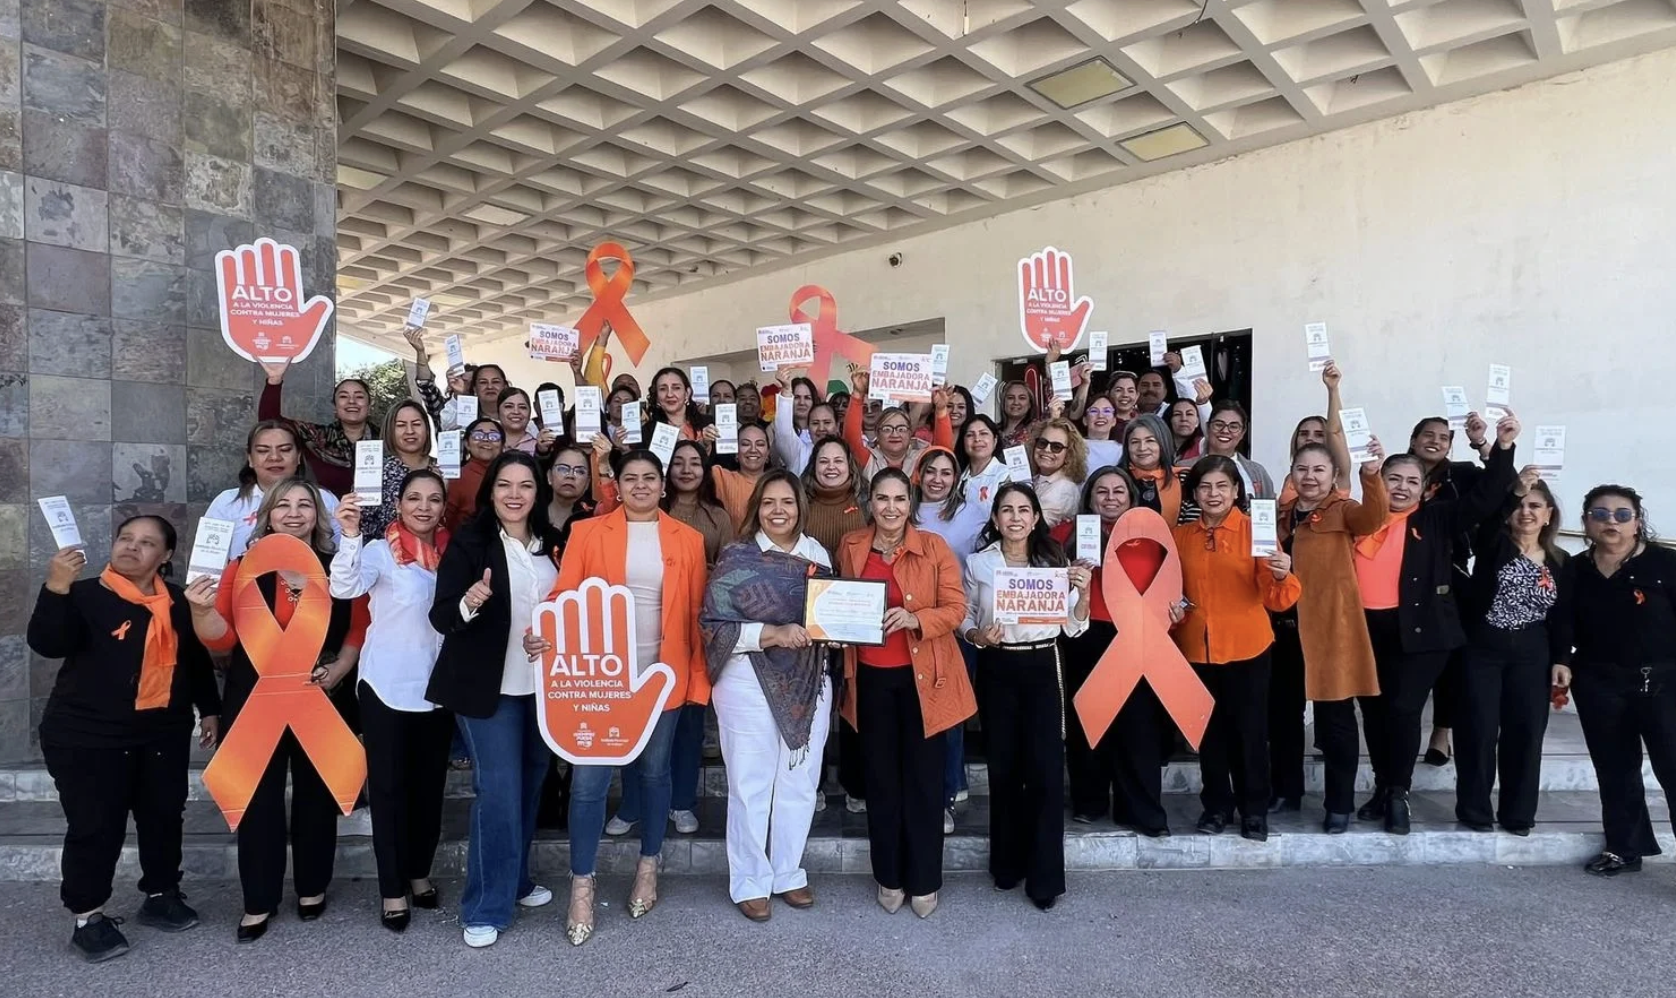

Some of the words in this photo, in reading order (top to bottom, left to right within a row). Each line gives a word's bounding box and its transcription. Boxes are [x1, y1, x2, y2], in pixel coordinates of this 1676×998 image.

[231, 285, 292, 302] ALTO
[1027, 287, 1067, 303] ALTO
[540, 330, 569, 341] SOMOS
[767, 333, 800, 344] SOMOS
[760, 341, 810, 352] EMBAJADORA
[760, 348, 811, 361] NARANJA
[883, 361, 920, 372] SOMOS
[872, 370, 930, 381] EMBAJADORA
[872, 378, 930, 391] NARANJA
[1008, 578, 1053, 590] SOMOS
[996, 590, 1065, 600] EMBAJADORA
[996, 599, 1065, 612] NARANJA
[549, 654, 623, 677] ALTO
[551, 680, 559, 688] A
[560, 680, 572, 688] LA
[573, 680, 624, 688] VIOLENCIA
[548, 691, 587, 699] CONTRA
[589, 691, 631, 699] MUJERES
[573, 704, 579, 712] Y
[581, 702, 611, 712] NIÑAS
